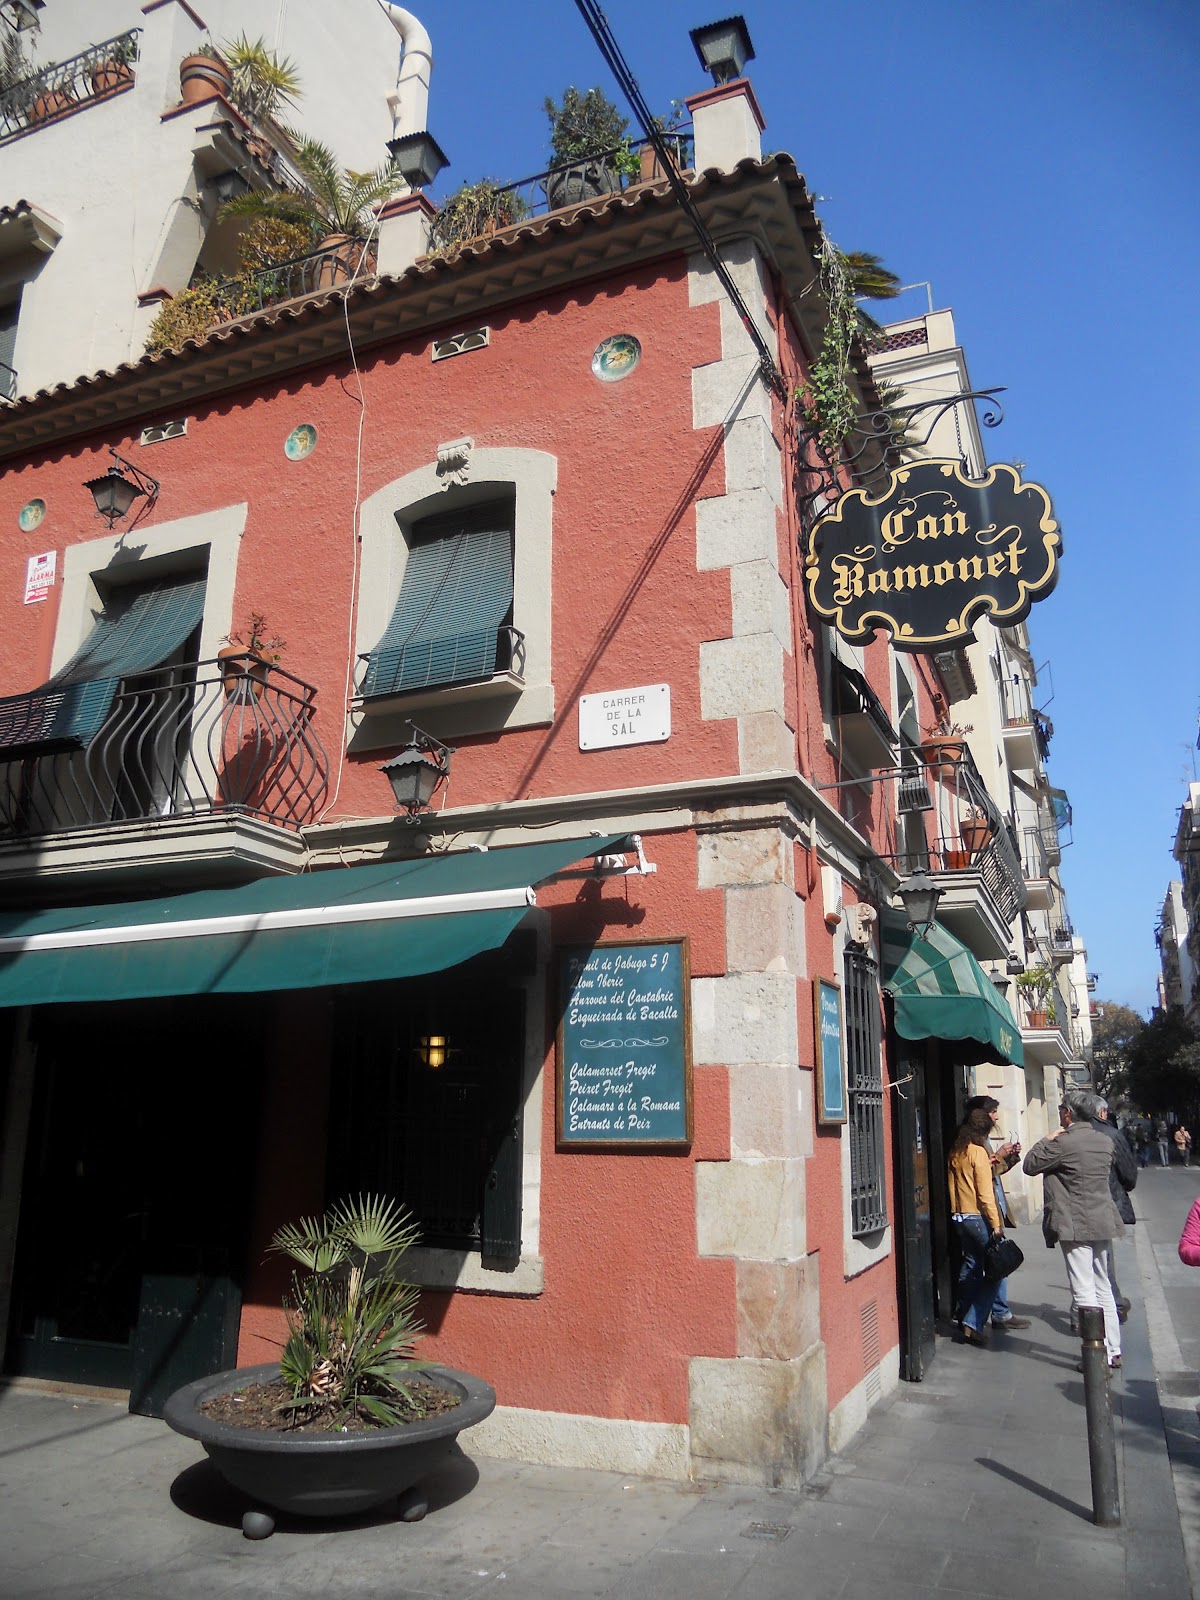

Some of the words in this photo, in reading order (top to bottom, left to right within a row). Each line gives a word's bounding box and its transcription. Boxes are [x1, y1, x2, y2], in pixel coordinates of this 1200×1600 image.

[881, 491, 970, 553] Can
[831, 526, 1027, 605] Ramonet
[29, 571, 54, 582] ALARMA
[603, 695, 645, 708] CARRER
[607, 711, 620, 720] DE
[627, 708, 642, 718] LA
[612, 722, 636, 736] SAL
[601, 957, 612, 971] de
[613, 955, 647, 974] Jabugo
[650, 953, 658, 968] 5
[660, 951, 670, 972] J
[596, 973, 624, 988] Iberic
[569, 991, 607, 1007] Anxoves
[610, 990, 625, 1005] del
[627, 988, 674, 1007] Cantabric
[569, 1009, 623, 1027] Esqueixada
[625, 1007, 637, 1021] de
[640, 1005, 678, 1021] Bacalla
[569, 1062, 623, 1080] Calamarset
[625, 1060, 657, 1080] Fregit
[569, 1080, 601, 1095] Peixet
[602, 1079, 634, 1098] Fregit
[569, 1097, 615, 1115] Calamars
[617, 1101, 624, 1112] a
[627, 1098, 637, 1111] la
[640, 1096, 681, 1112] Romana
[569, 1115, 611, 1132] Entrants
[613, 1115, 625, 1130] de
[628, 1114, 651, 1131] Peix
